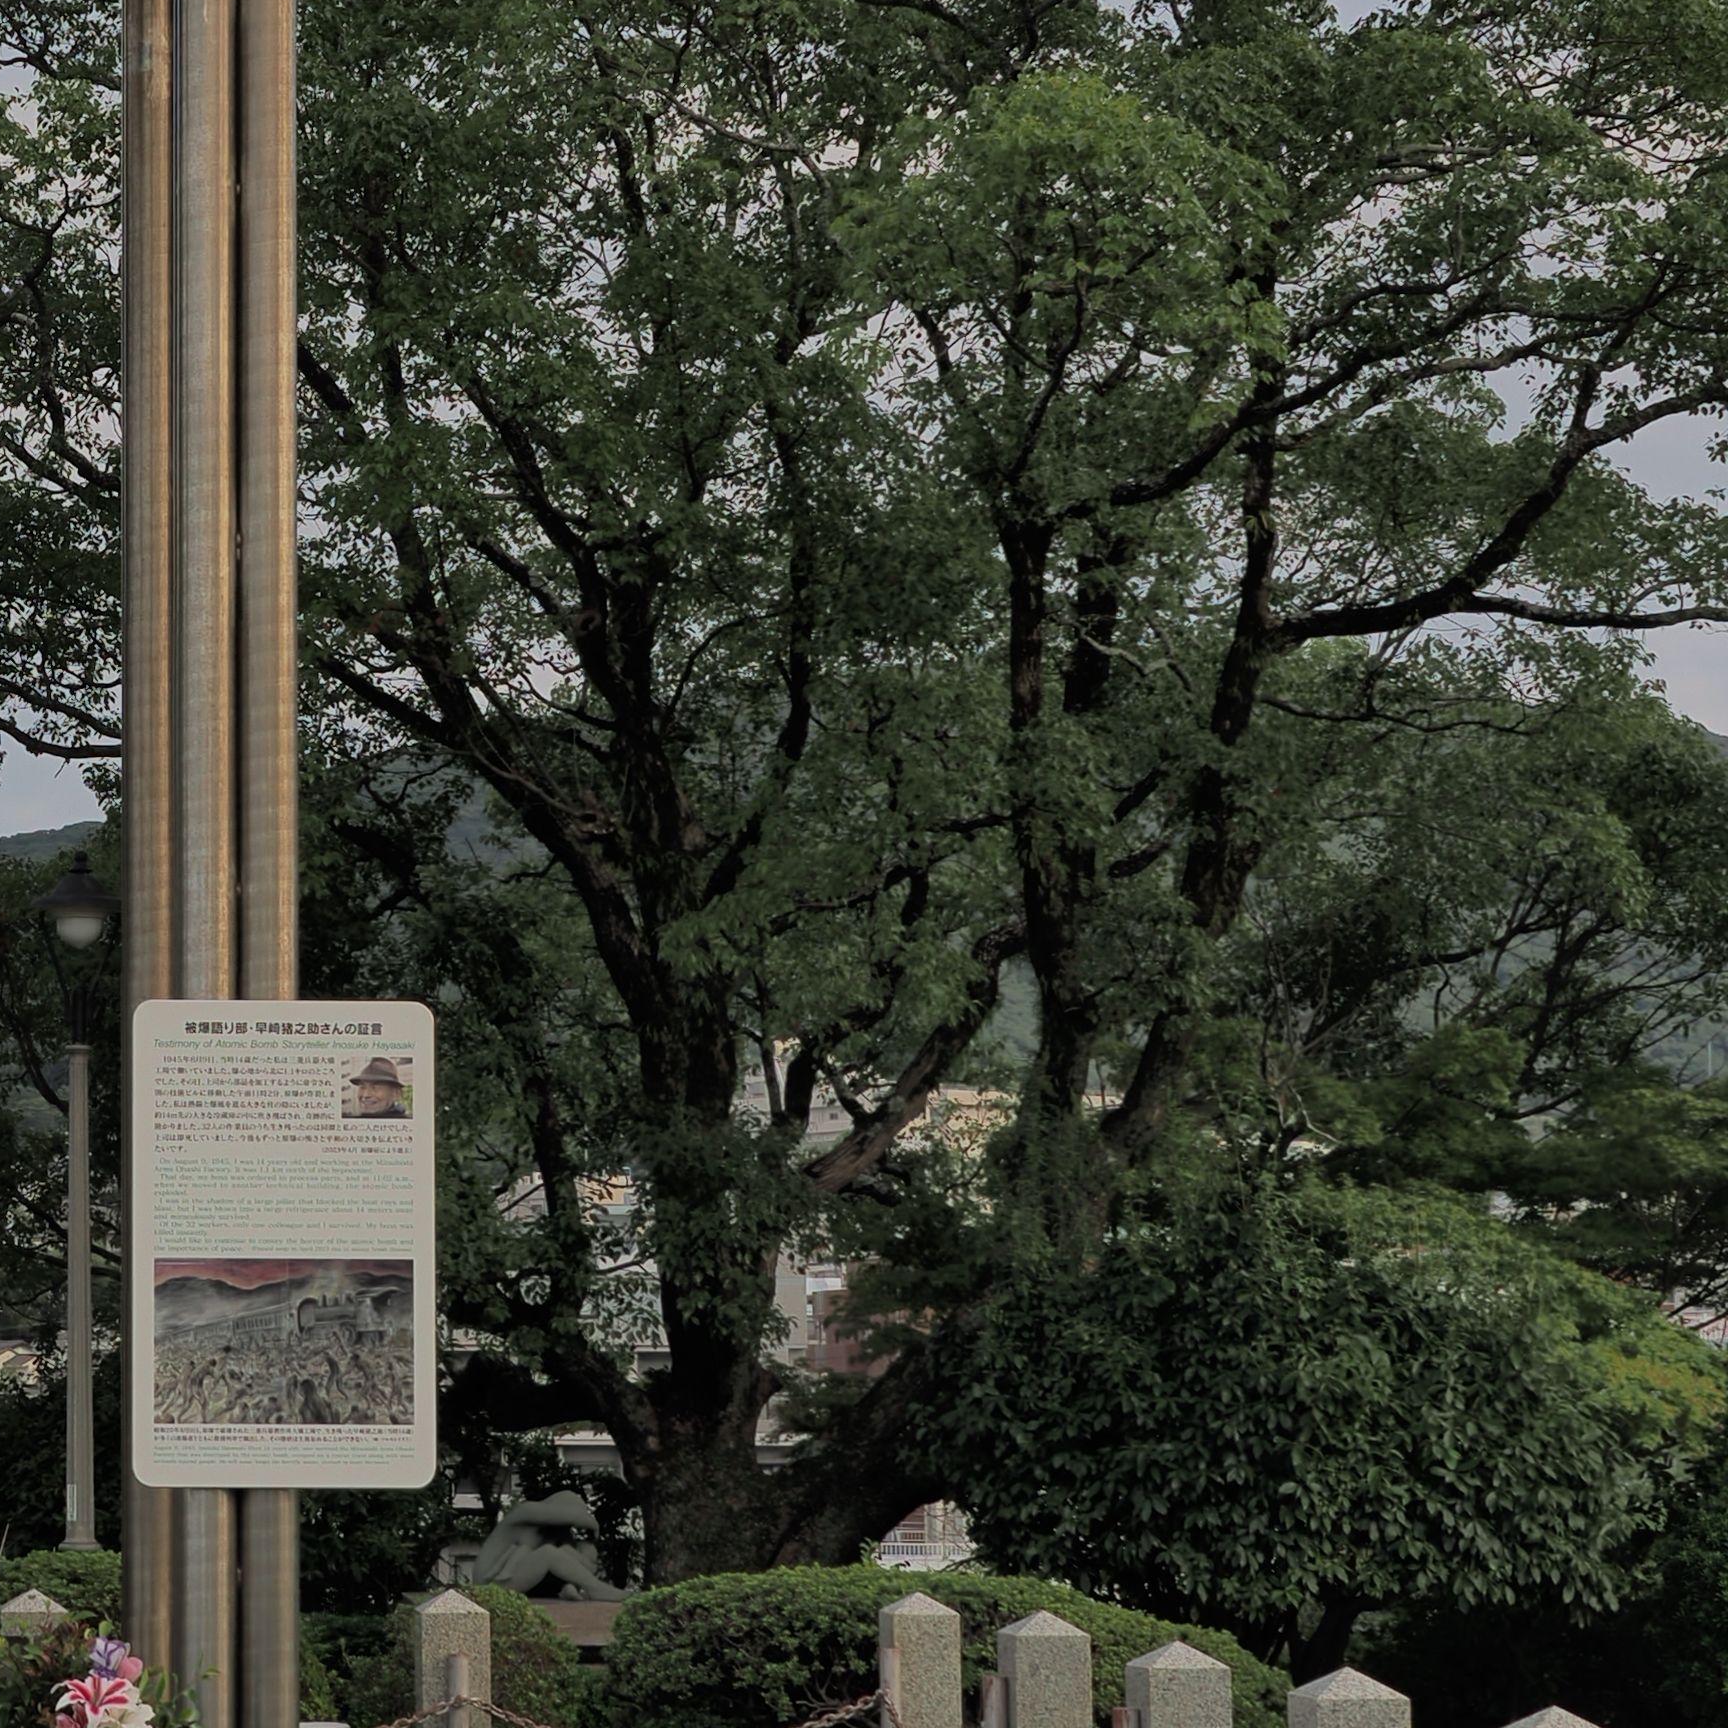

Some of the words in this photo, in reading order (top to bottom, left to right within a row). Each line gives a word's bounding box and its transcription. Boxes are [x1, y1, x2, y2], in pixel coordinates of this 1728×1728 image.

[185, 1022, 383, 1036] 被爆語り部・早崎猪之助さんの証言
[154, 1039, 201, 1050] Testimony
[202, 1039, 213, 1048] of
[214, 1039, 249, 1048] Atomic
[250, 1039, 280, 1048] Bomb
[280, 1039, 331, 1050] Storyteller
[332, 1039, 370, 1048] Inosuke
[372, 1040, 416, 1051] Hayasaki
